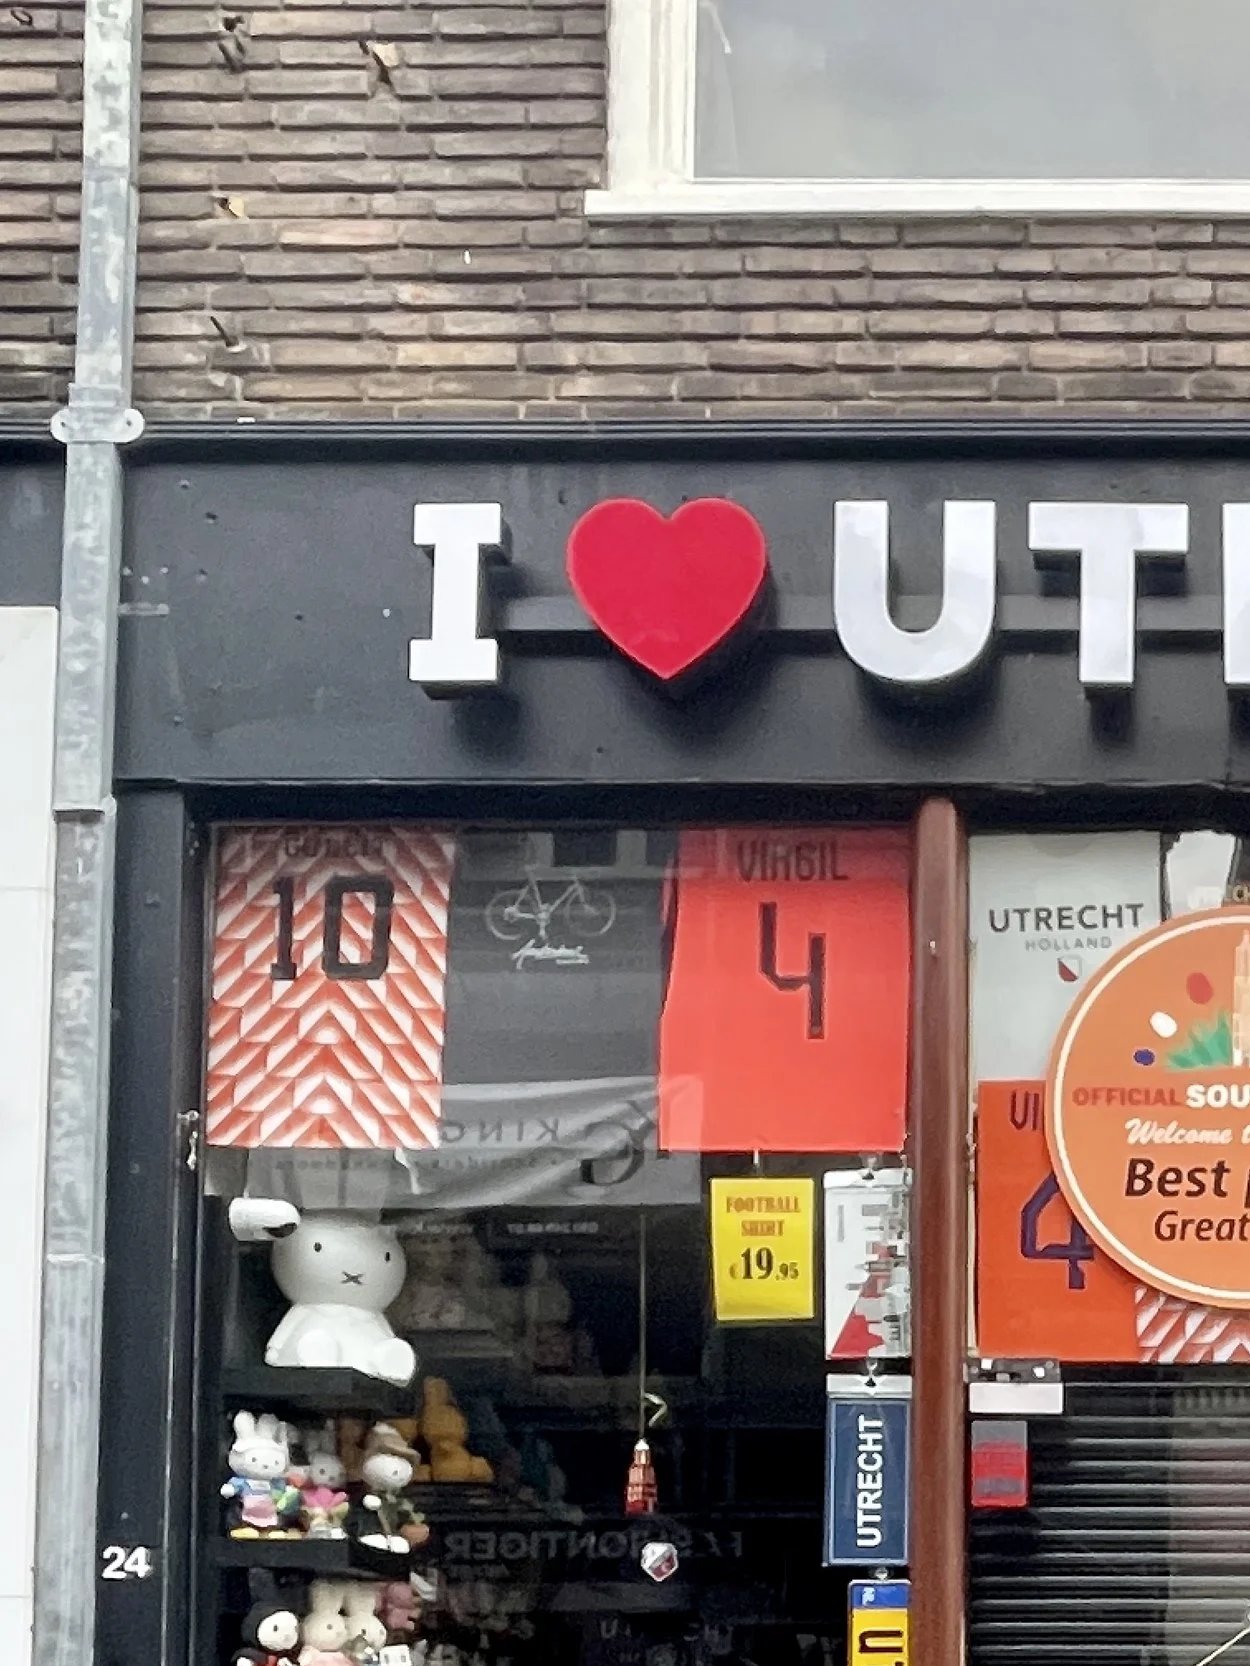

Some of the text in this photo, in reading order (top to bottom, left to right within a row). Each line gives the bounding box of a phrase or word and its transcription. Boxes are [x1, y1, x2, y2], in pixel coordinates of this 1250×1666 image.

[408, 502, 503, 684] I
[737, 839, 849, 882] VIRGIL
[271, 874, 394, 980] 10
[988, 903, 1144, 932] UTRECHT
[1025, 936, 1112, 951] HOLLAND
[758, 901, 826, 1038] 4
[1072, 1087, 1184, 1107] OFFICIAL
[1125, 1117, 1232, 1145] Welcome
[1124, 1157, 1231, 1198] Best
[726, 1196, 802, 1213] FOOTBALL
[741, 1220, 785, 1236] SHIRT
[1020, 1170, 1095, 1290] 4
[1154, 1210, 1250, 1242] Great
[856, 1413, 883, 1550] UTRECHT
[101, 1546, 152, 1580] 24
